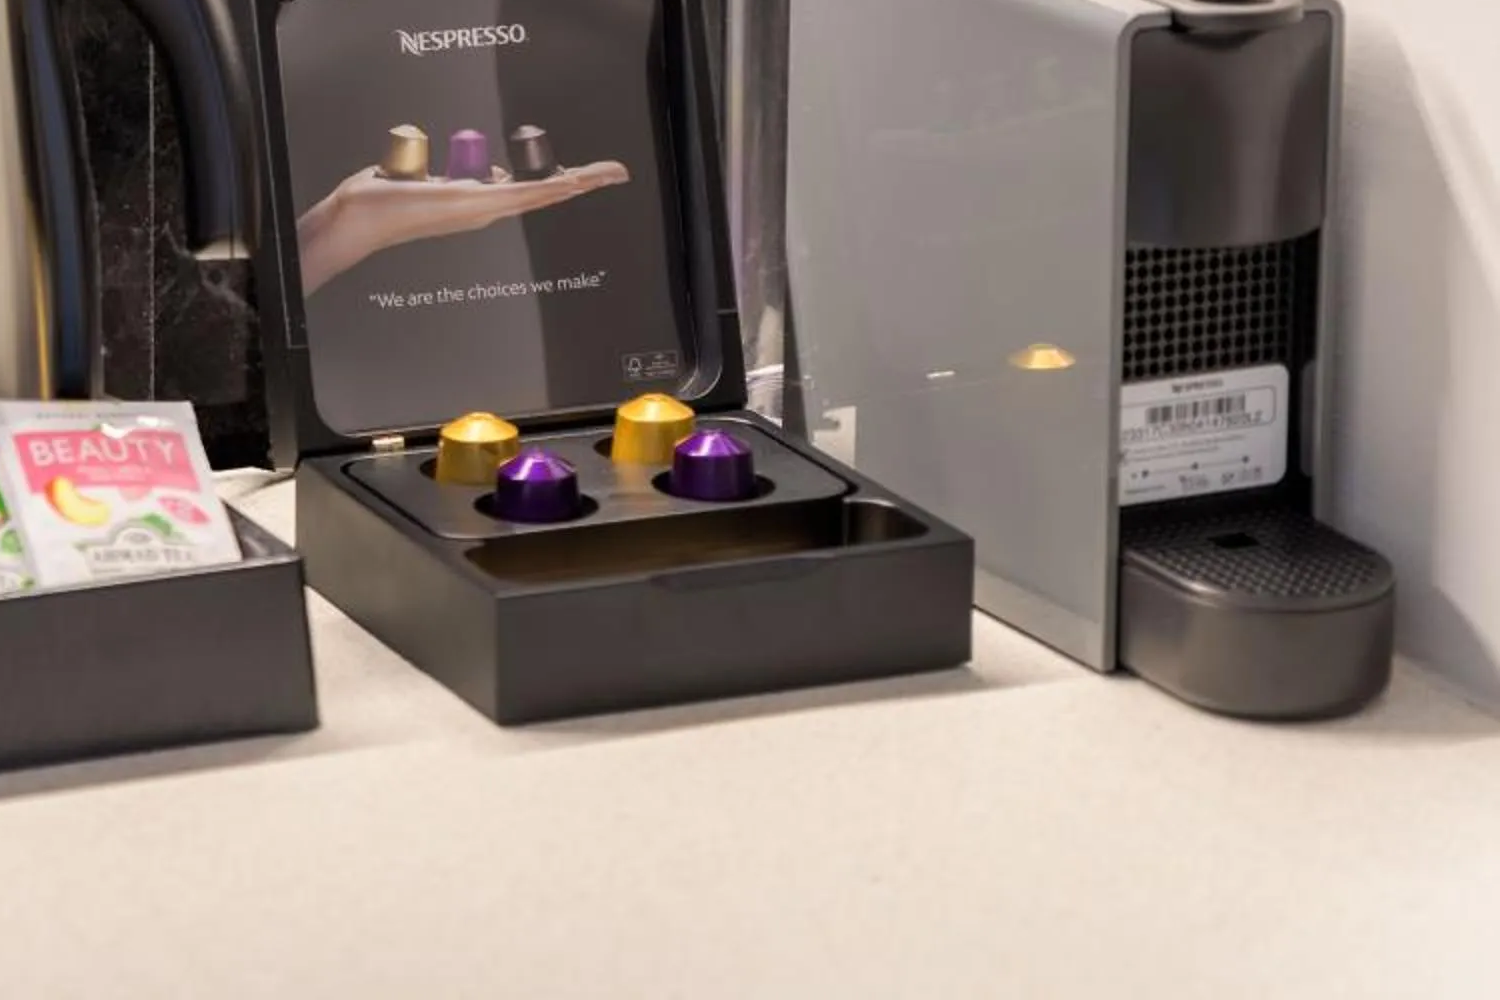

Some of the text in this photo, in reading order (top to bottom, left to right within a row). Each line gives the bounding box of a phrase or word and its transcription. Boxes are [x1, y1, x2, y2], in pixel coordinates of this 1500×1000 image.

[395, 23, 526, 57] NESPRESSO
[407, 291, 433, 306] are
[437, 286, 465, 302] the
[467, 282, 527, 300] choices
[529, 279, 553, 293] we
[28, 436, 176, 467] BEAUTY
